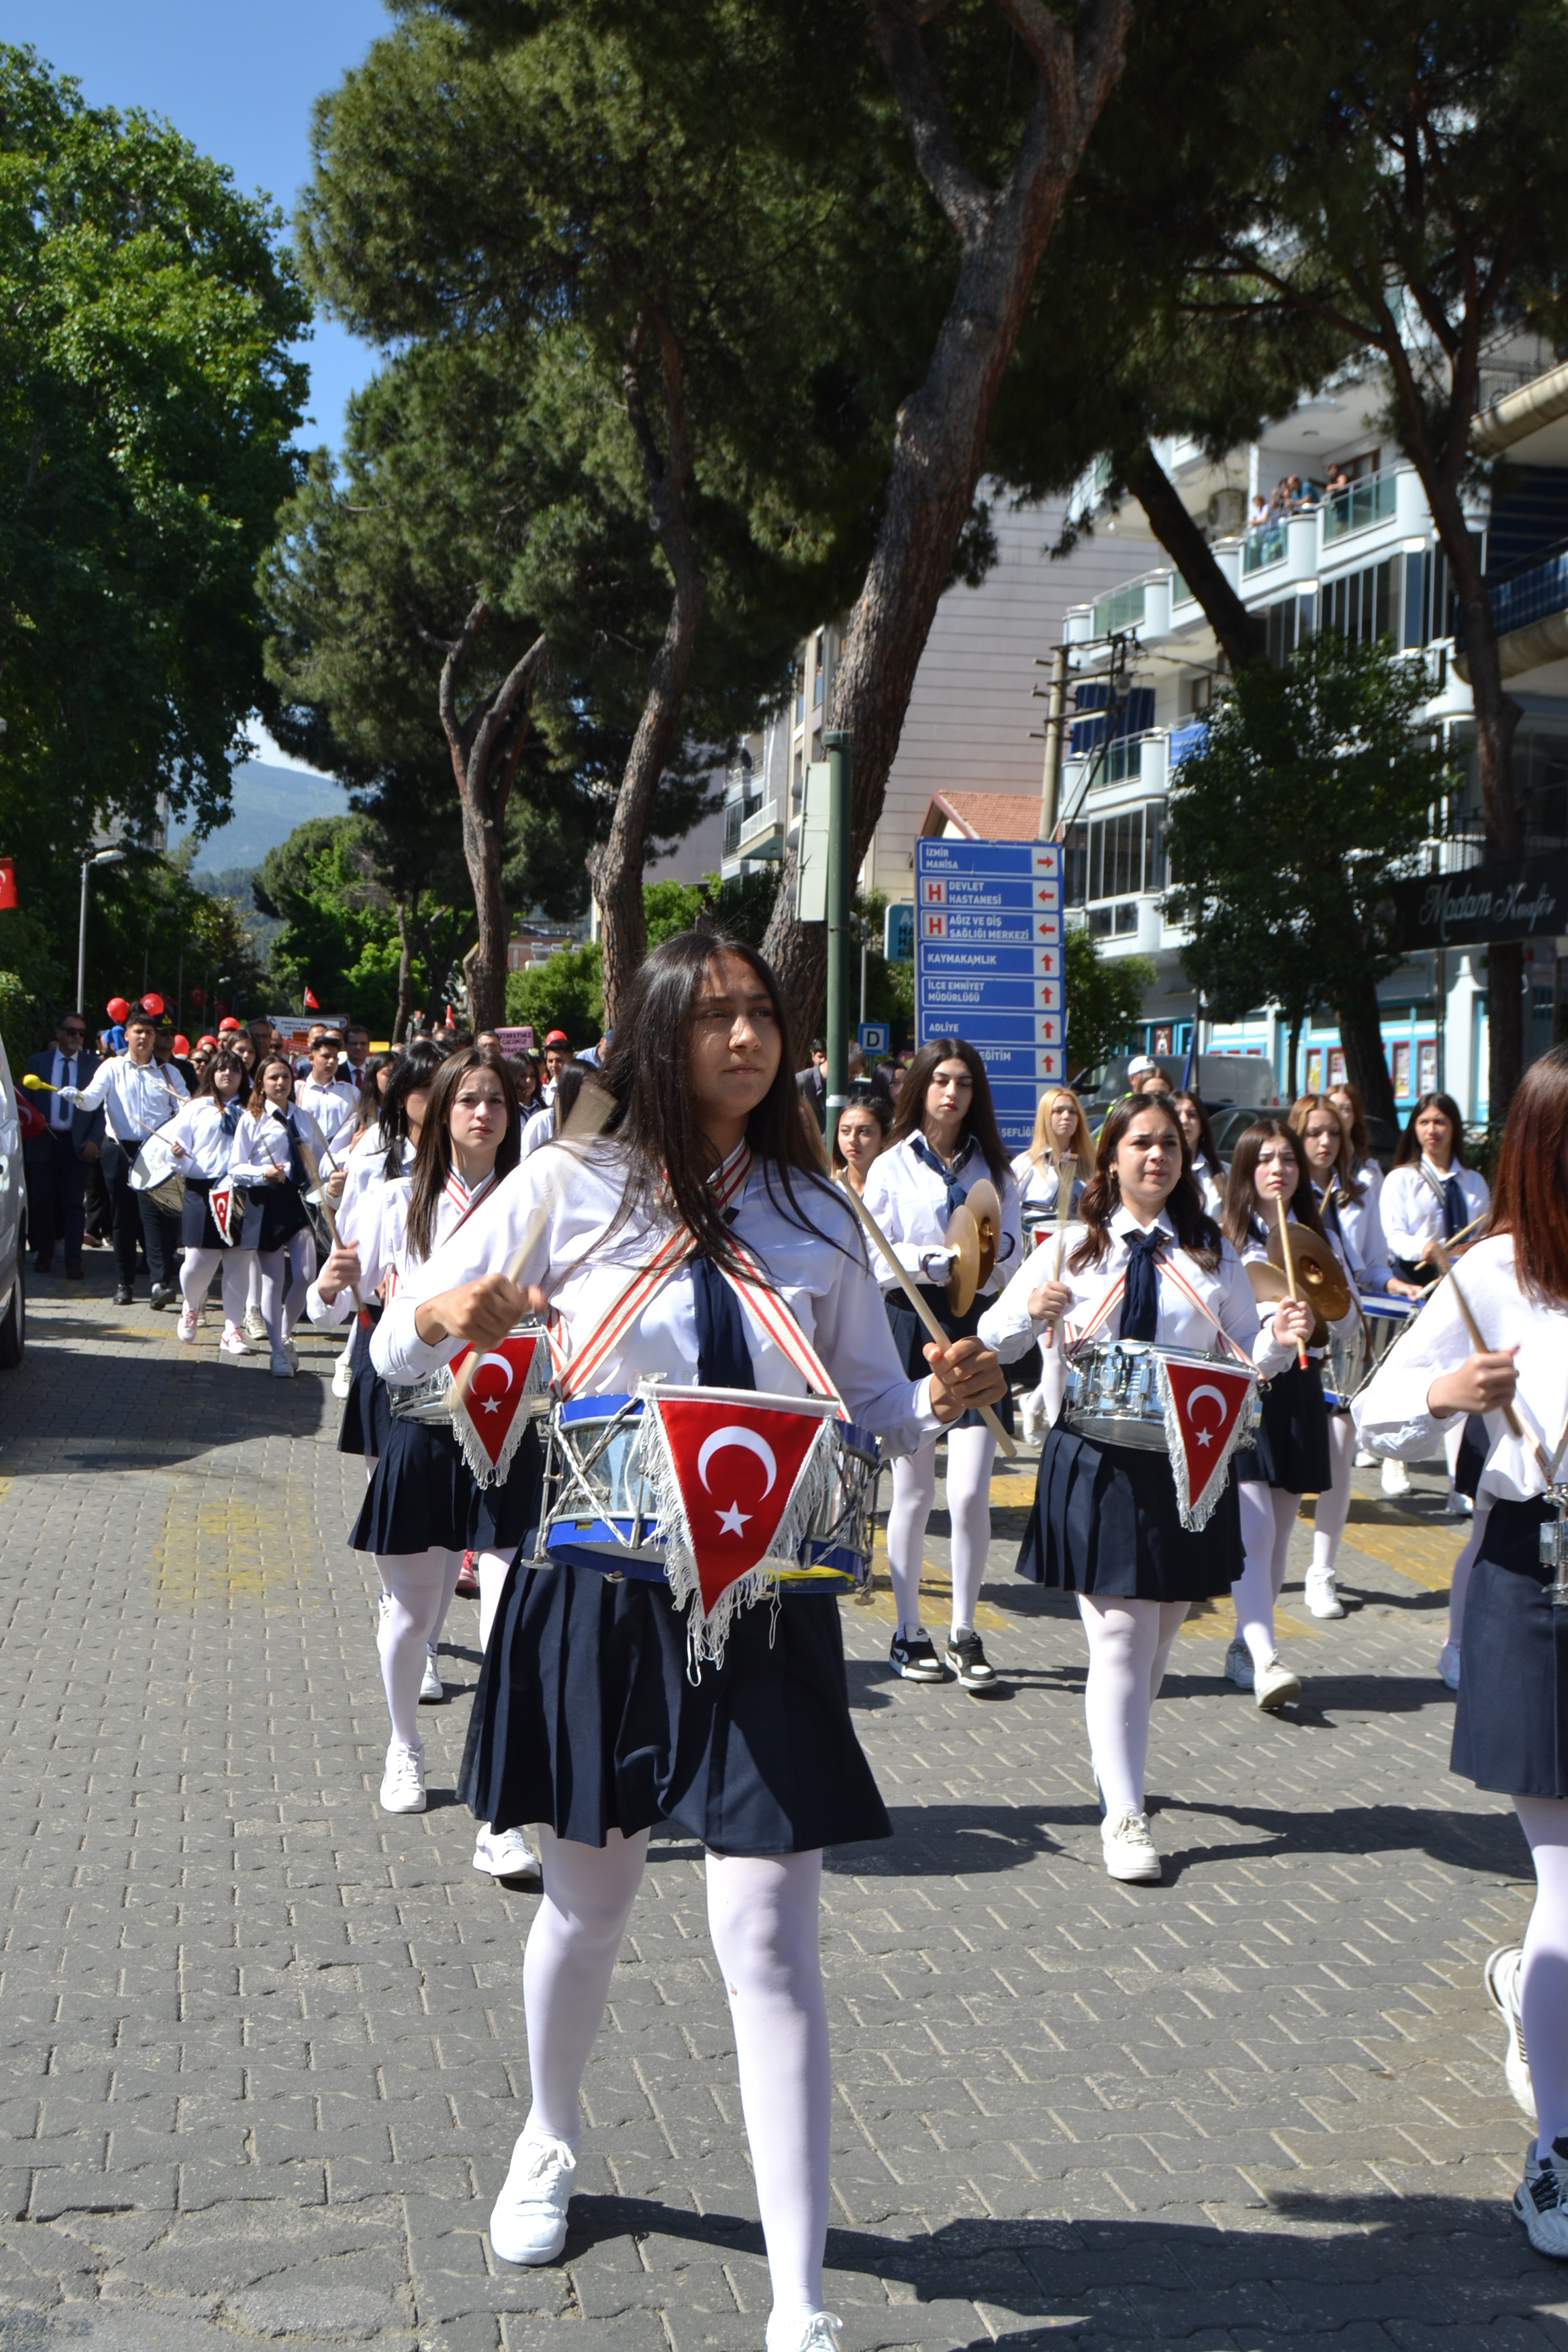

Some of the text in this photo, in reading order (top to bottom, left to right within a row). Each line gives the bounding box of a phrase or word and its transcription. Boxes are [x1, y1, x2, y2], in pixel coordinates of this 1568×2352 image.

[926, 846, 949, 858] İZMİR
[926, 858, 959, 870] MANİSA
[928, 883, 942, 901] H
[949, 881, 985, 892] DEVLET
[949, 893, 1002, 905] HASTANESİ
[1418, 879, 1492, 943] Madam
[928, 917, 943, 934] H
[949, 913, 1002, 928] AĞIZ VE DİŞ
[949, 927, 1030, 940] SAĞLIĞI MERKEZİ
[928, 953, 997, 965] KAYMAKAMLIK
[928, 979, 985, 991] İLÇE EMNİYET
[928, 991, 980, 1002] MÜDÜRLÜĞÜ
[929, 1022, 960, 1032] ADLİYE
[866, 1030, 880, 1047] D
[979, 1049, 1011, 1061] EĞİTİM
